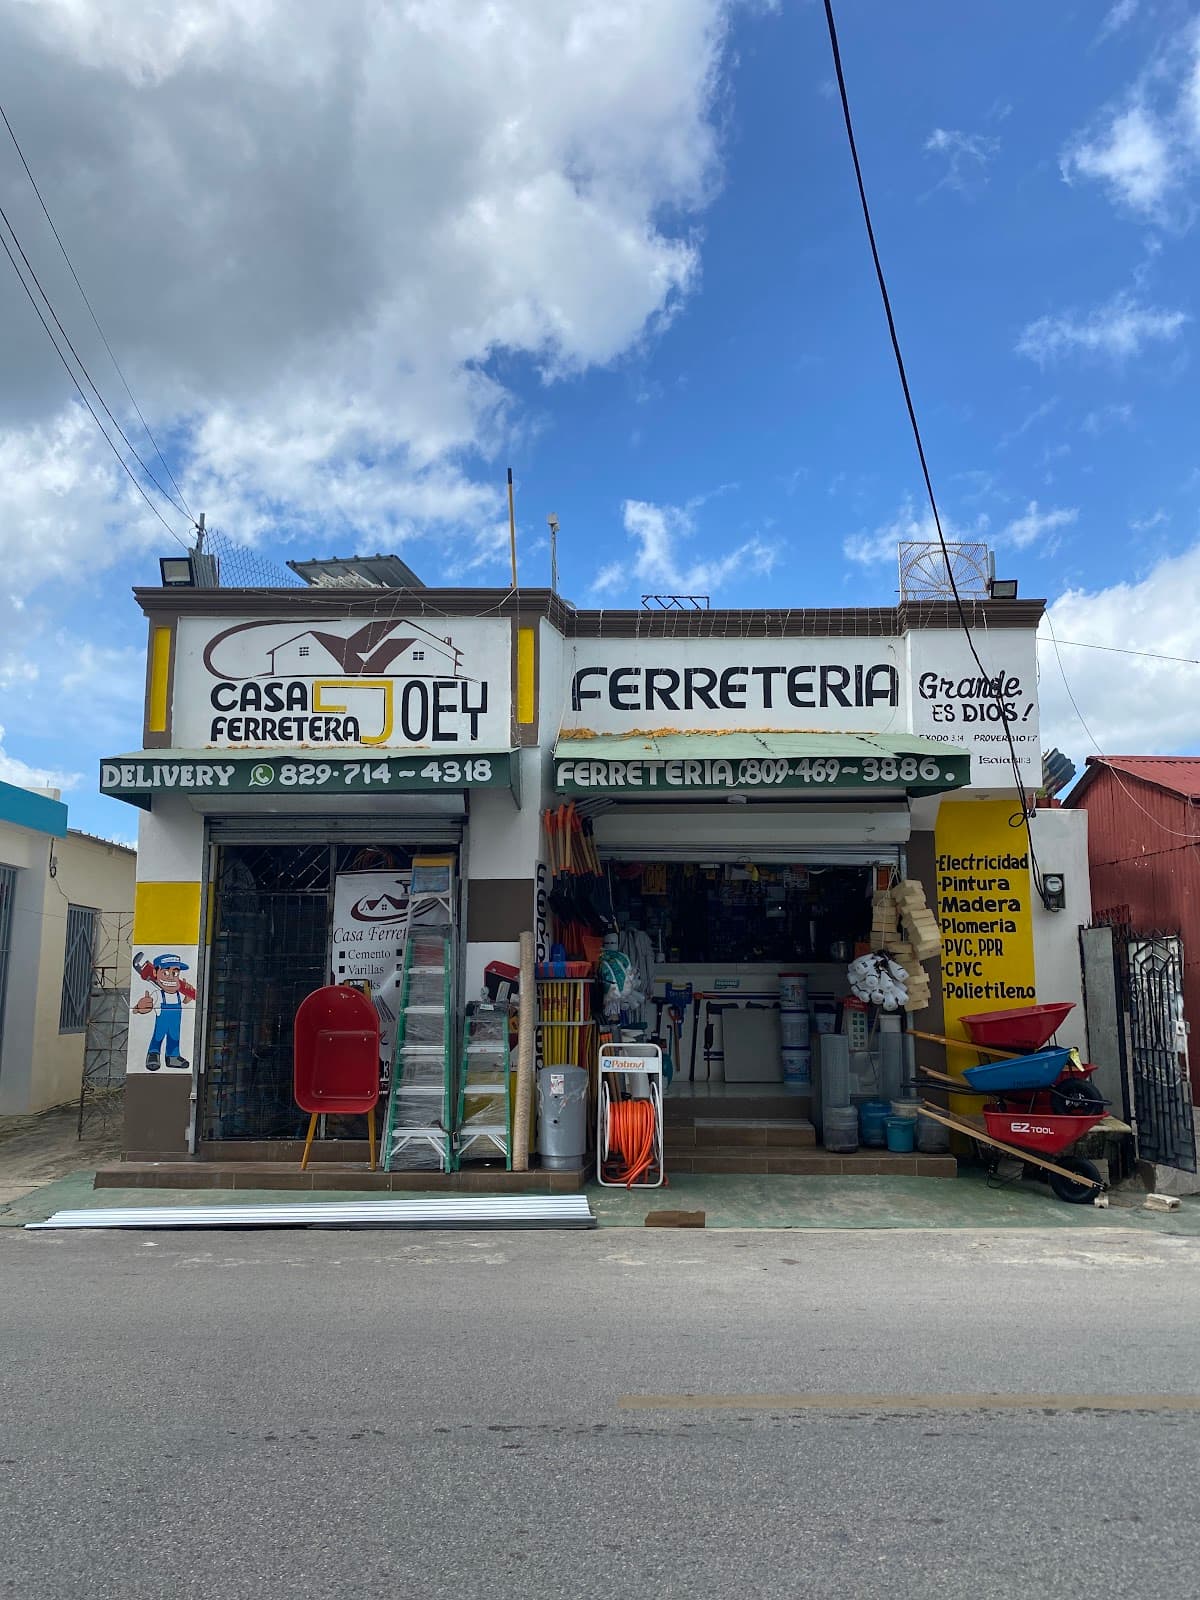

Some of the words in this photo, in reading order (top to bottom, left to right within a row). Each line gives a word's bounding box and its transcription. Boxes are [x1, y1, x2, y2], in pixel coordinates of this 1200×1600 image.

[571, 664, 899, 711] FERRETERIA
[919, 670, 1023, 700] Grande
[210, 681, 308, 713] CASA
[932, 703, 956, 722] ES
[211, 716, 361, 742] FERRETERA
[102, 764, 235, 788] DELIVERY
[552, 757, 734, 787] FERRETERIA
[938, 853, 1029, 872] Electricidad
[941, 875, 1011, 892] Pintura
[941, 896, 1021, 913] Madera
[941, 917, 1017, 934] Plomeria
[333, 927, 364, 944] Casa
[347, 949, 391, 960] Cemento
[347, 963, 385, 976] Varillas
[944, 961, 984, 977] CPVC
[944, 981, 1037, 999] Polietileno
[1010, 1122, 1031, 1133] EZ
[1031, 1125, 1055, 1135] TOOL
